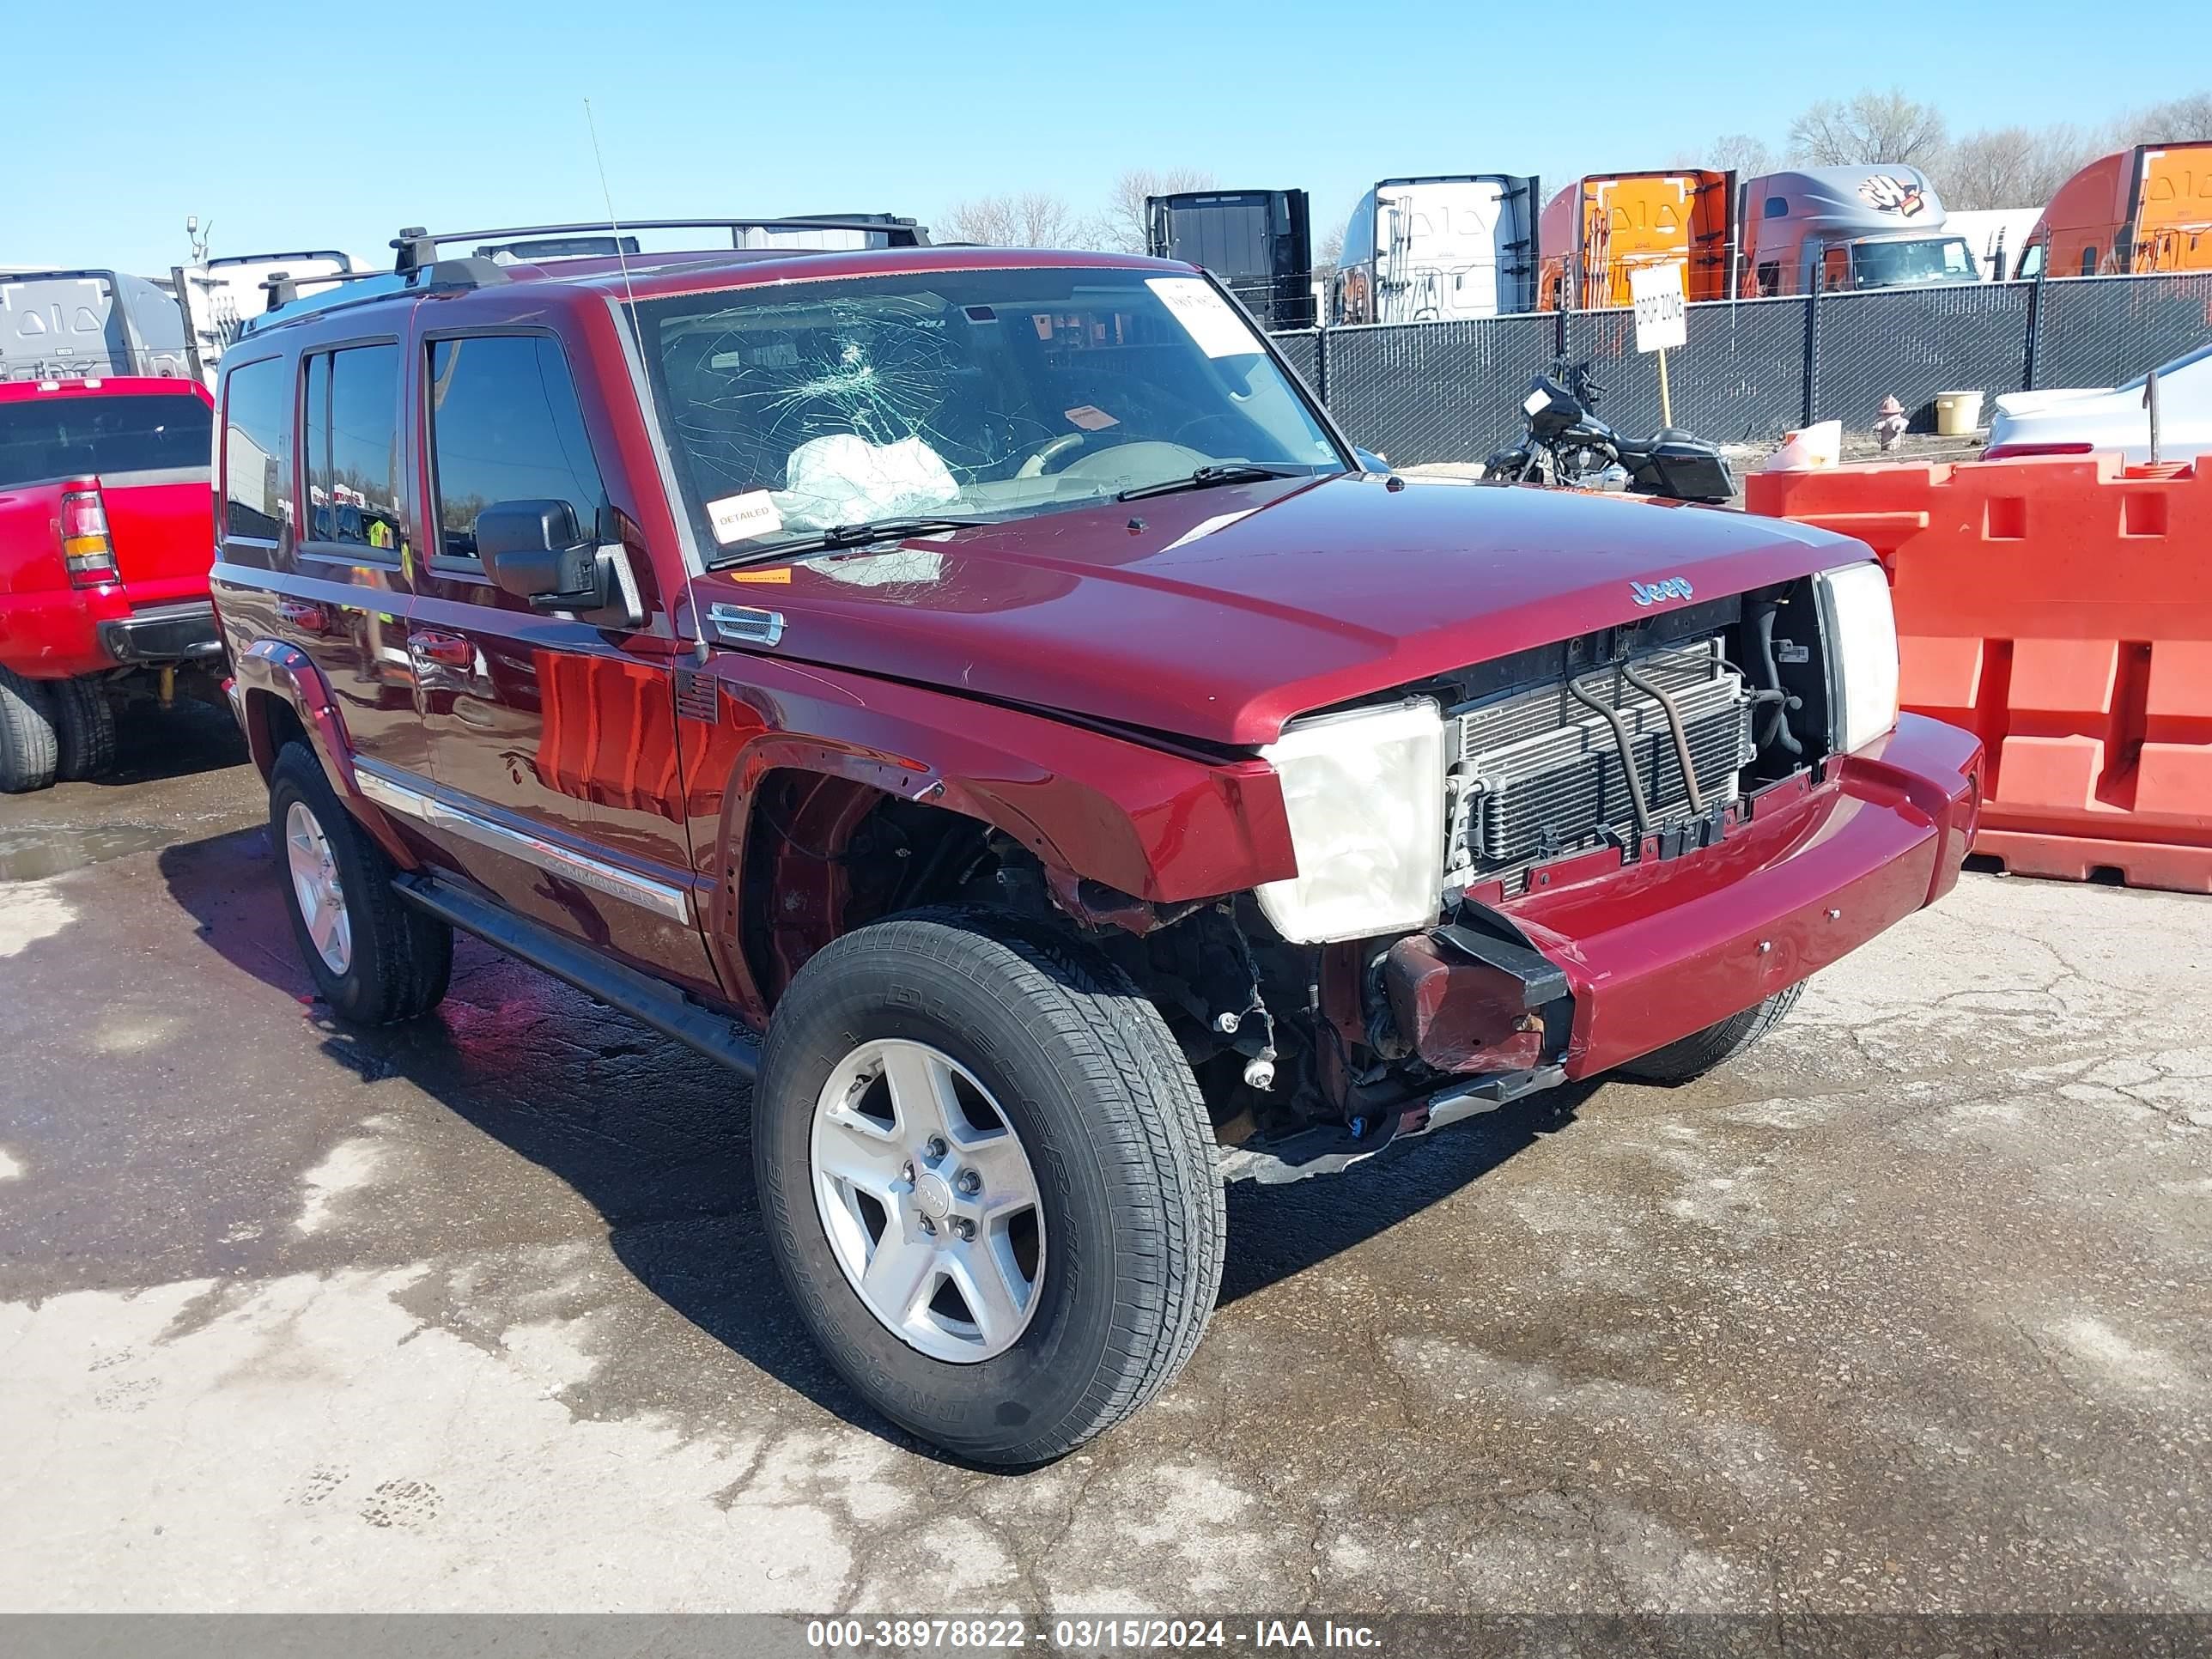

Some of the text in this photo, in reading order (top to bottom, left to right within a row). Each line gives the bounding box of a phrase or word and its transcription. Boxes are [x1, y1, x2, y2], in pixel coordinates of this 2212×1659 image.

[1636, 291, 1682, 325] DROP ZONE
[720, 507, 769, 526] DETAILED
[1629, 576, 1693, 606] Jeep
[544, 857, 656, 907] COMMANDER
